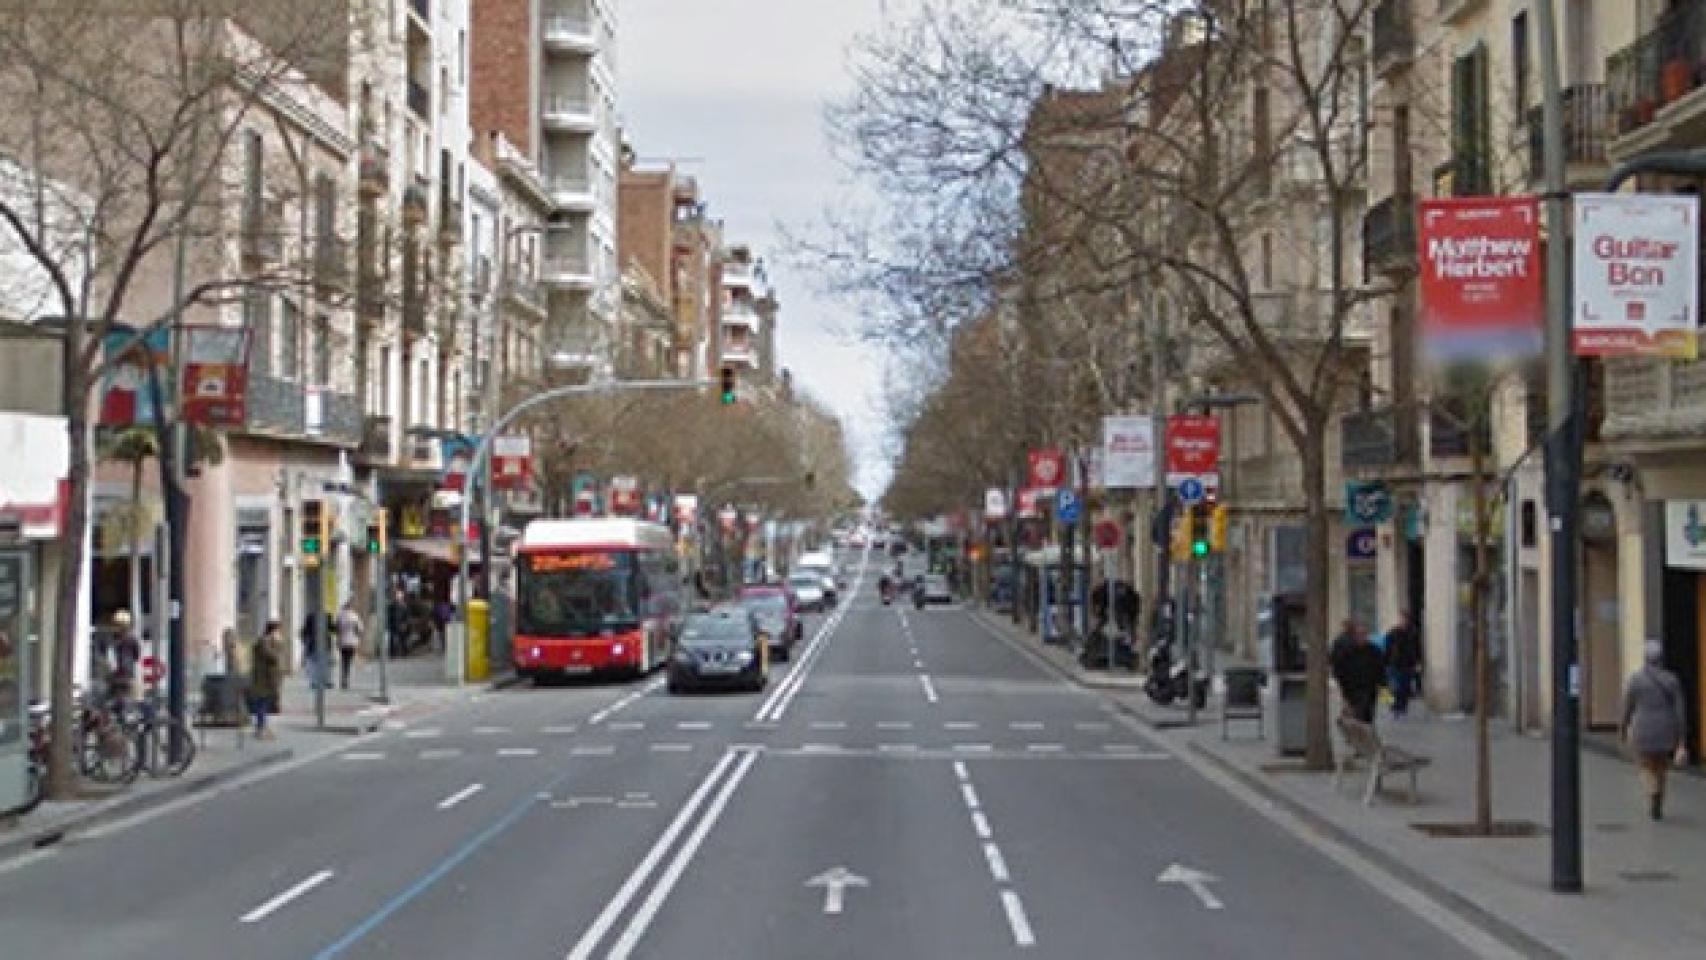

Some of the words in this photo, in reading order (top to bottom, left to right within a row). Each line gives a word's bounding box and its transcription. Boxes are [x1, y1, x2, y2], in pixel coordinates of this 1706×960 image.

[1428, 237, 1531, 259] Matthew
[1593, 235, 1679, 259] Guitar
[1436, 257, 1527, 279] Herbert
